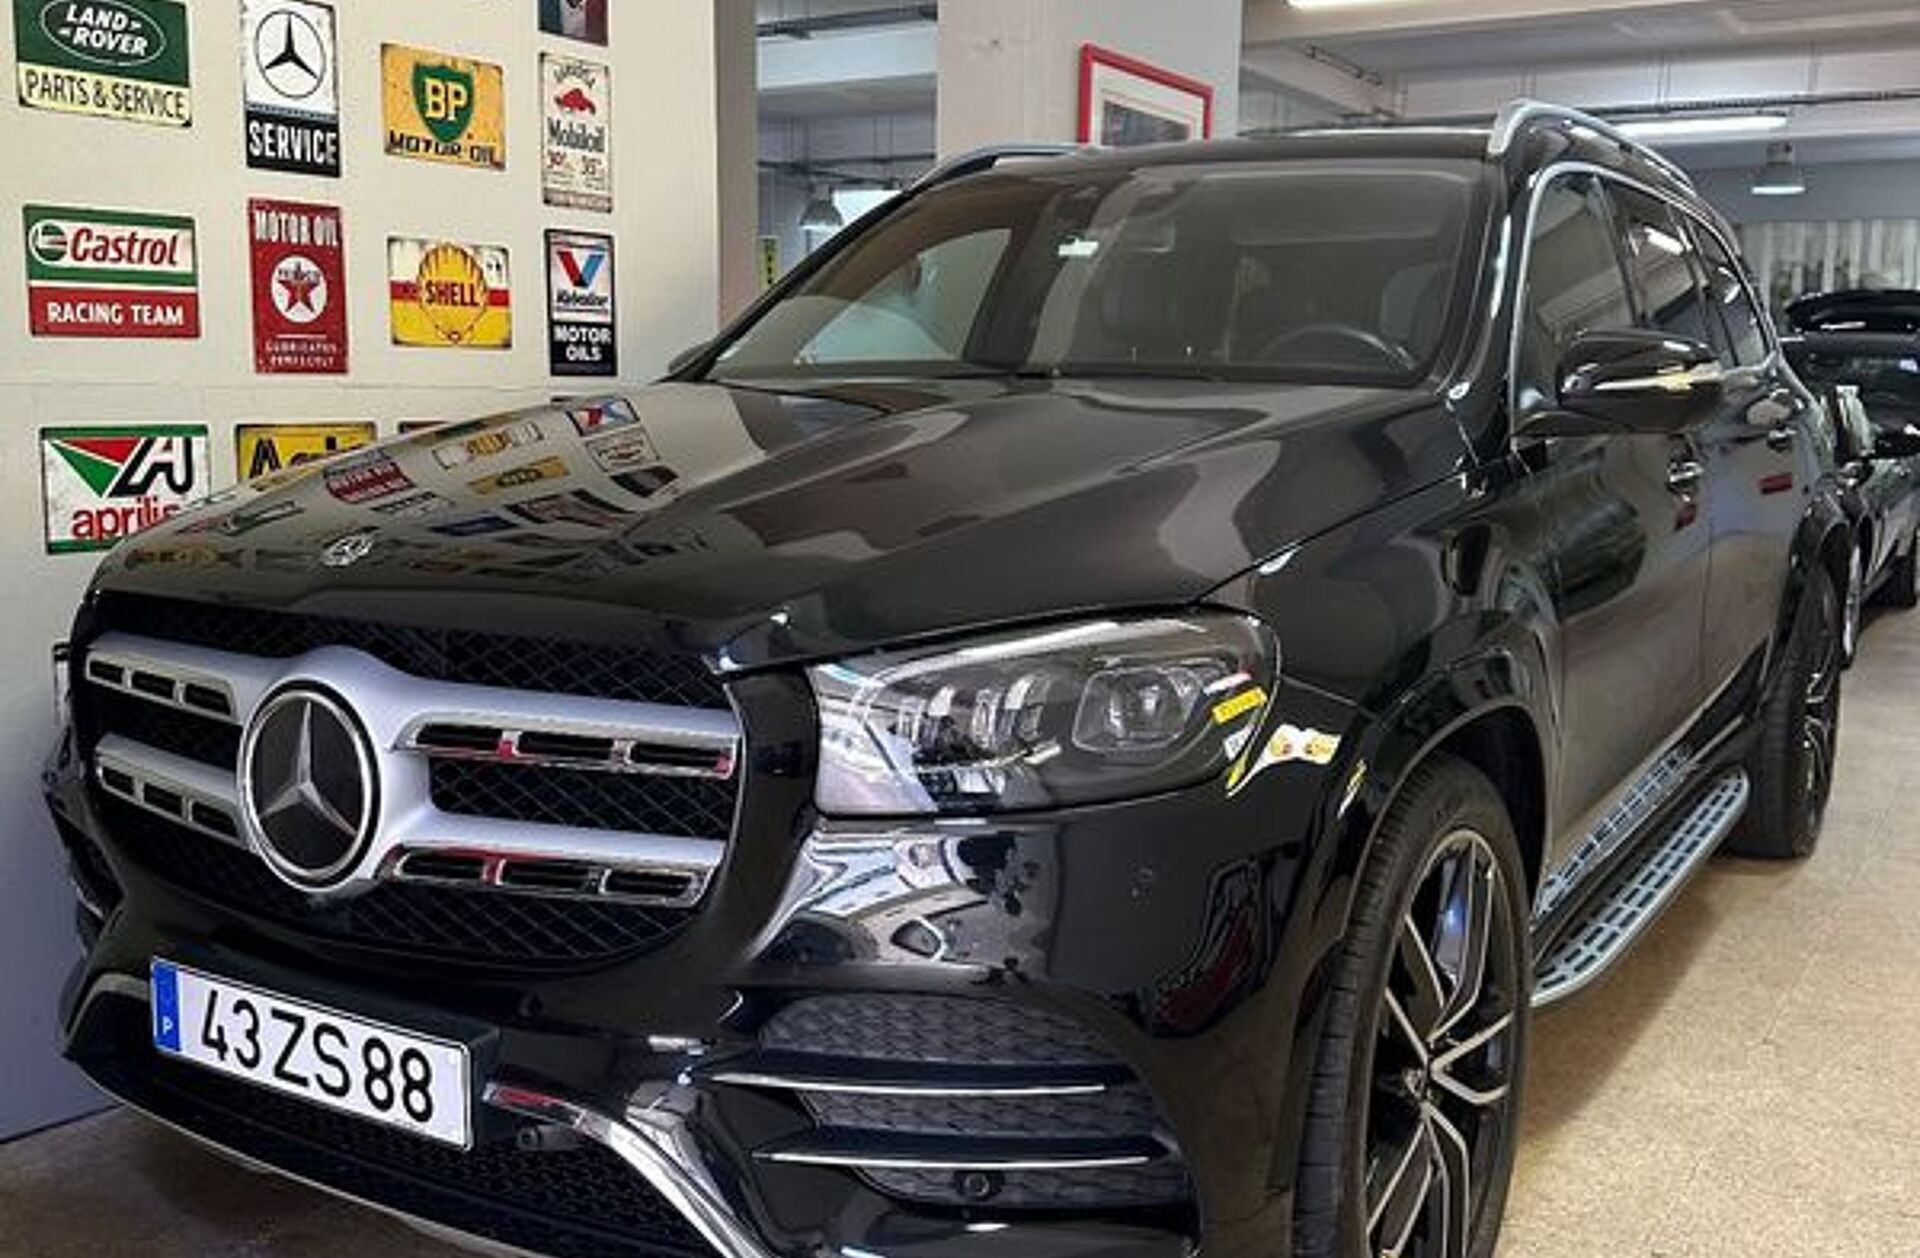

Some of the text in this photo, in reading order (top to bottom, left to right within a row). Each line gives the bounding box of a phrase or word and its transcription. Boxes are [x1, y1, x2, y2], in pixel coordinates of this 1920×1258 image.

[24, 68, 90, 106] PARTS
[111, 82, 185, 120] SERVICE
[425, 78, 468, 121] BP
[249, 120, 337, 165] SERVICE
[389, 129, 461, 157] MOTOR
[255, 210, 311, 246] MOTOR
[70, 227, 178, 266] Castrol
[425, 279, 480, 307] SHELL
[47, 301, 184, 326] RACING TEAM
[553, 325, 612, 344] MOTOR
[565, 344, 603, 361] OILS
[162, 1016, 173, 1035] P
